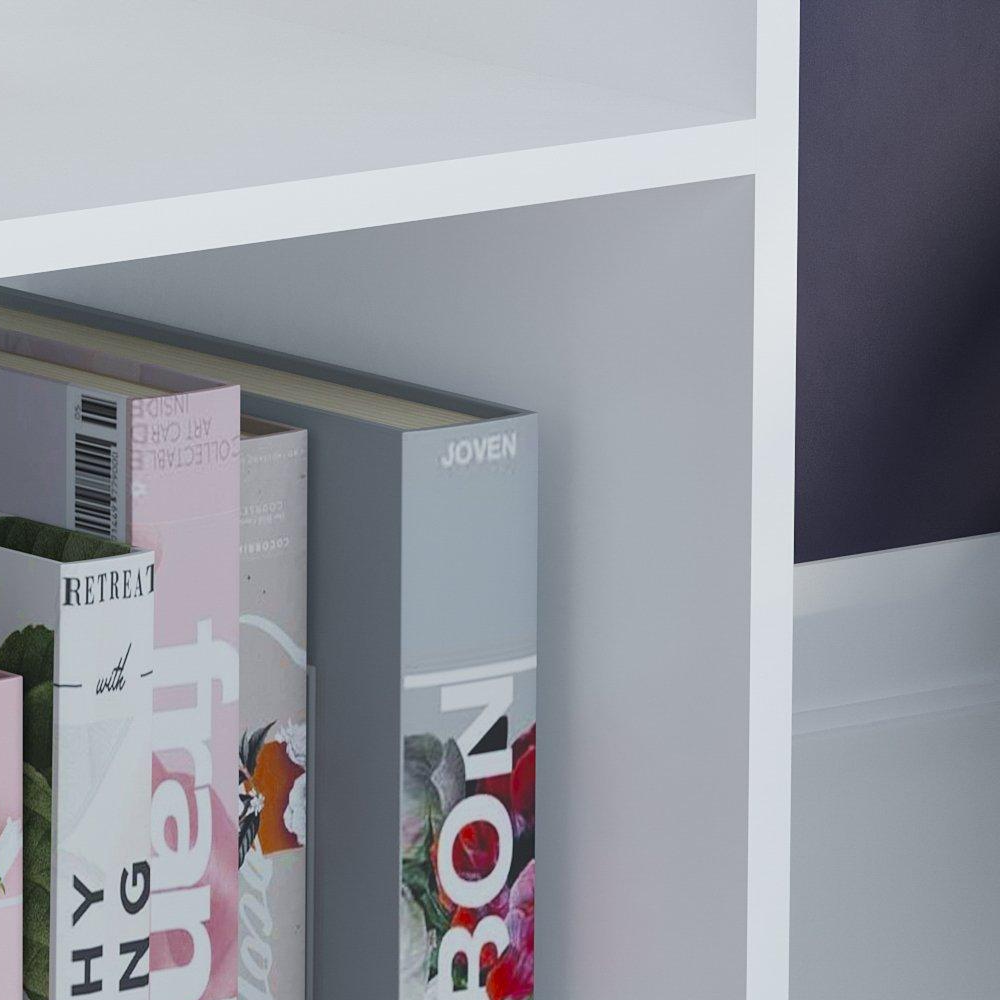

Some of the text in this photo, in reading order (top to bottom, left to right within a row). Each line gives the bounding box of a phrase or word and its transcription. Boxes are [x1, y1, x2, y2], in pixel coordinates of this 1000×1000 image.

[133, 394, 189, 417] INSIDE
[133, 416, 212, 445] ART CARD
[440, 430, 517, 468] JOVEN
[62, 563, 155, 606] RETREAT
[96, 642, 132, 696] with
